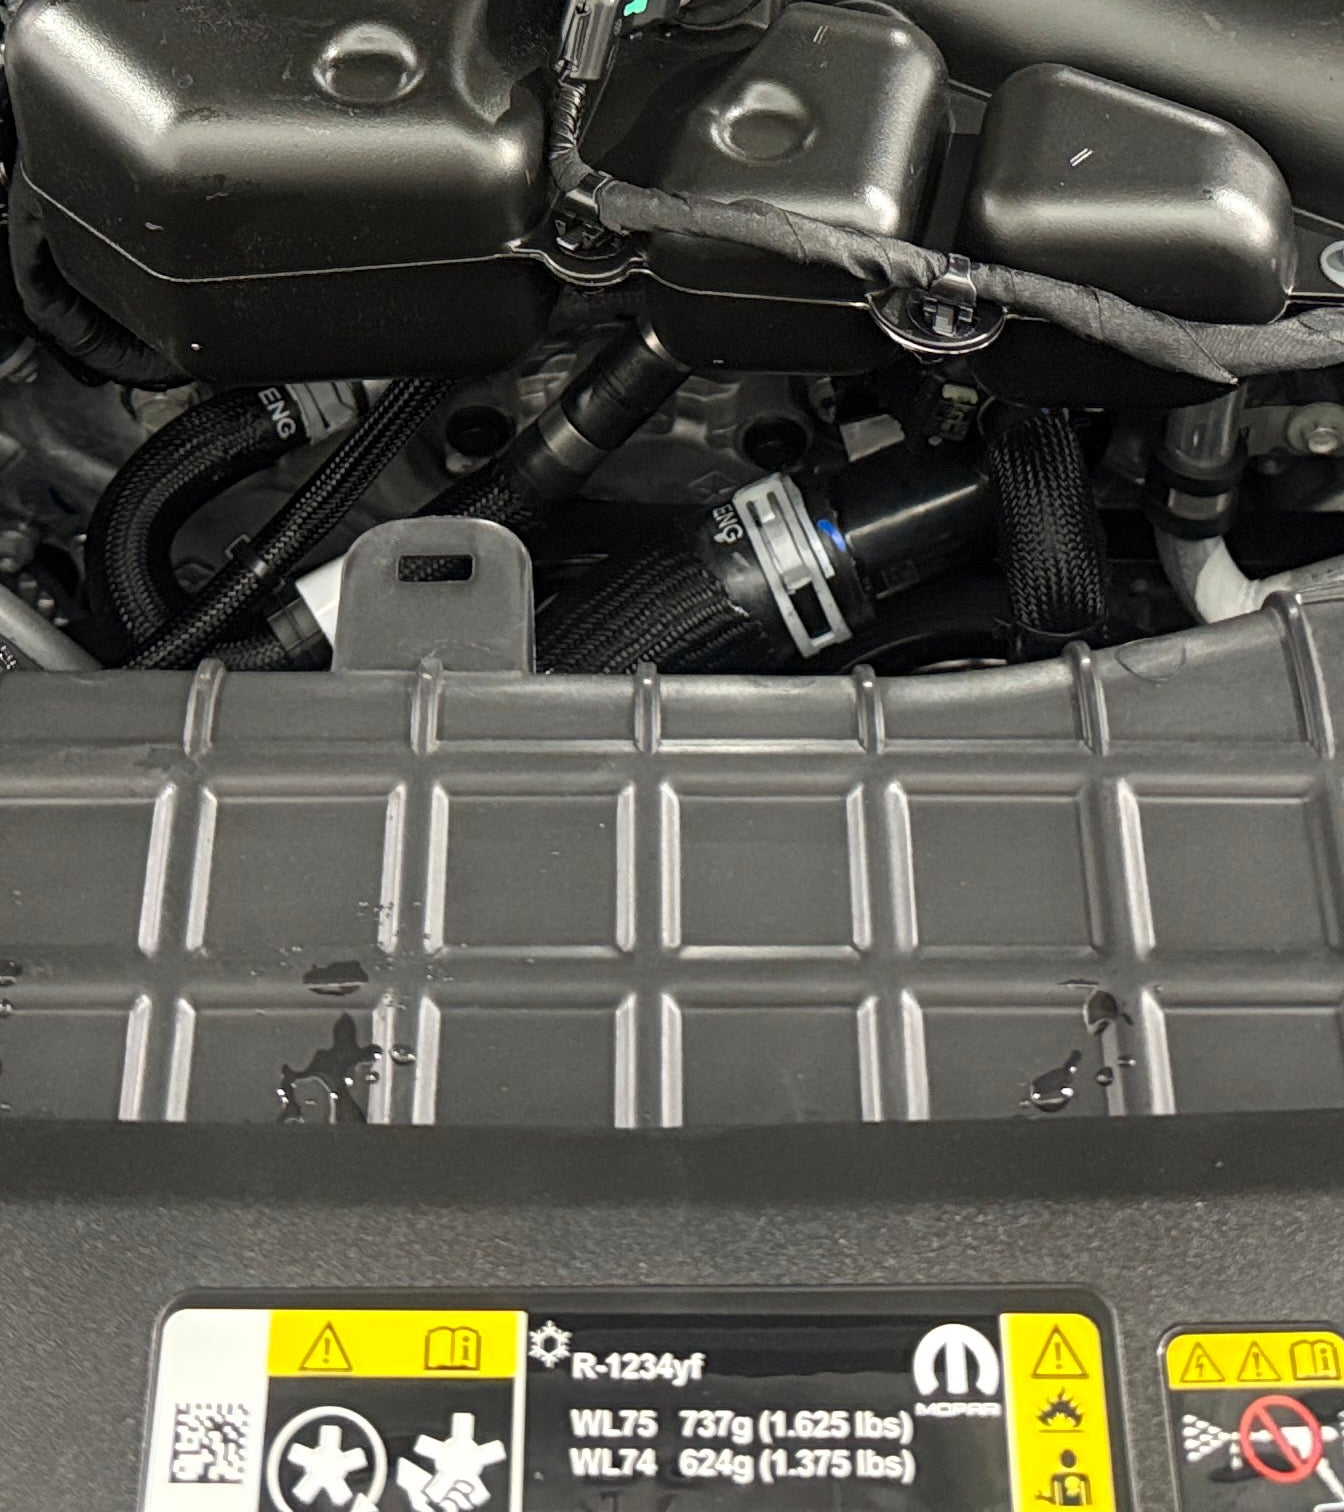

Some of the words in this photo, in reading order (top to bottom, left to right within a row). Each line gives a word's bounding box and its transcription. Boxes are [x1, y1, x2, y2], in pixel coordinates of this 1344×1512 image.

[258, 387, 296, 441] ENG
[711, 503, 744, 544] ENG
[570, 1352, 706, 1387] R-1234yf
[569, 1409, 658, 1439] WL75
[678, 1409, 754, 1445] 737g
[759, 1409, 851, 1444] (1.625
[855, 1409, 914, 1444] lbs)
[914, 1401, 1002, 1418] MOPAR
[569, 1447, 658, 1477] WL74
[678, 1447, 754, 1484] 624g
[759, 1448, 853, 1485] (1.375
[856, 1448, 916, 1485] lbs)
